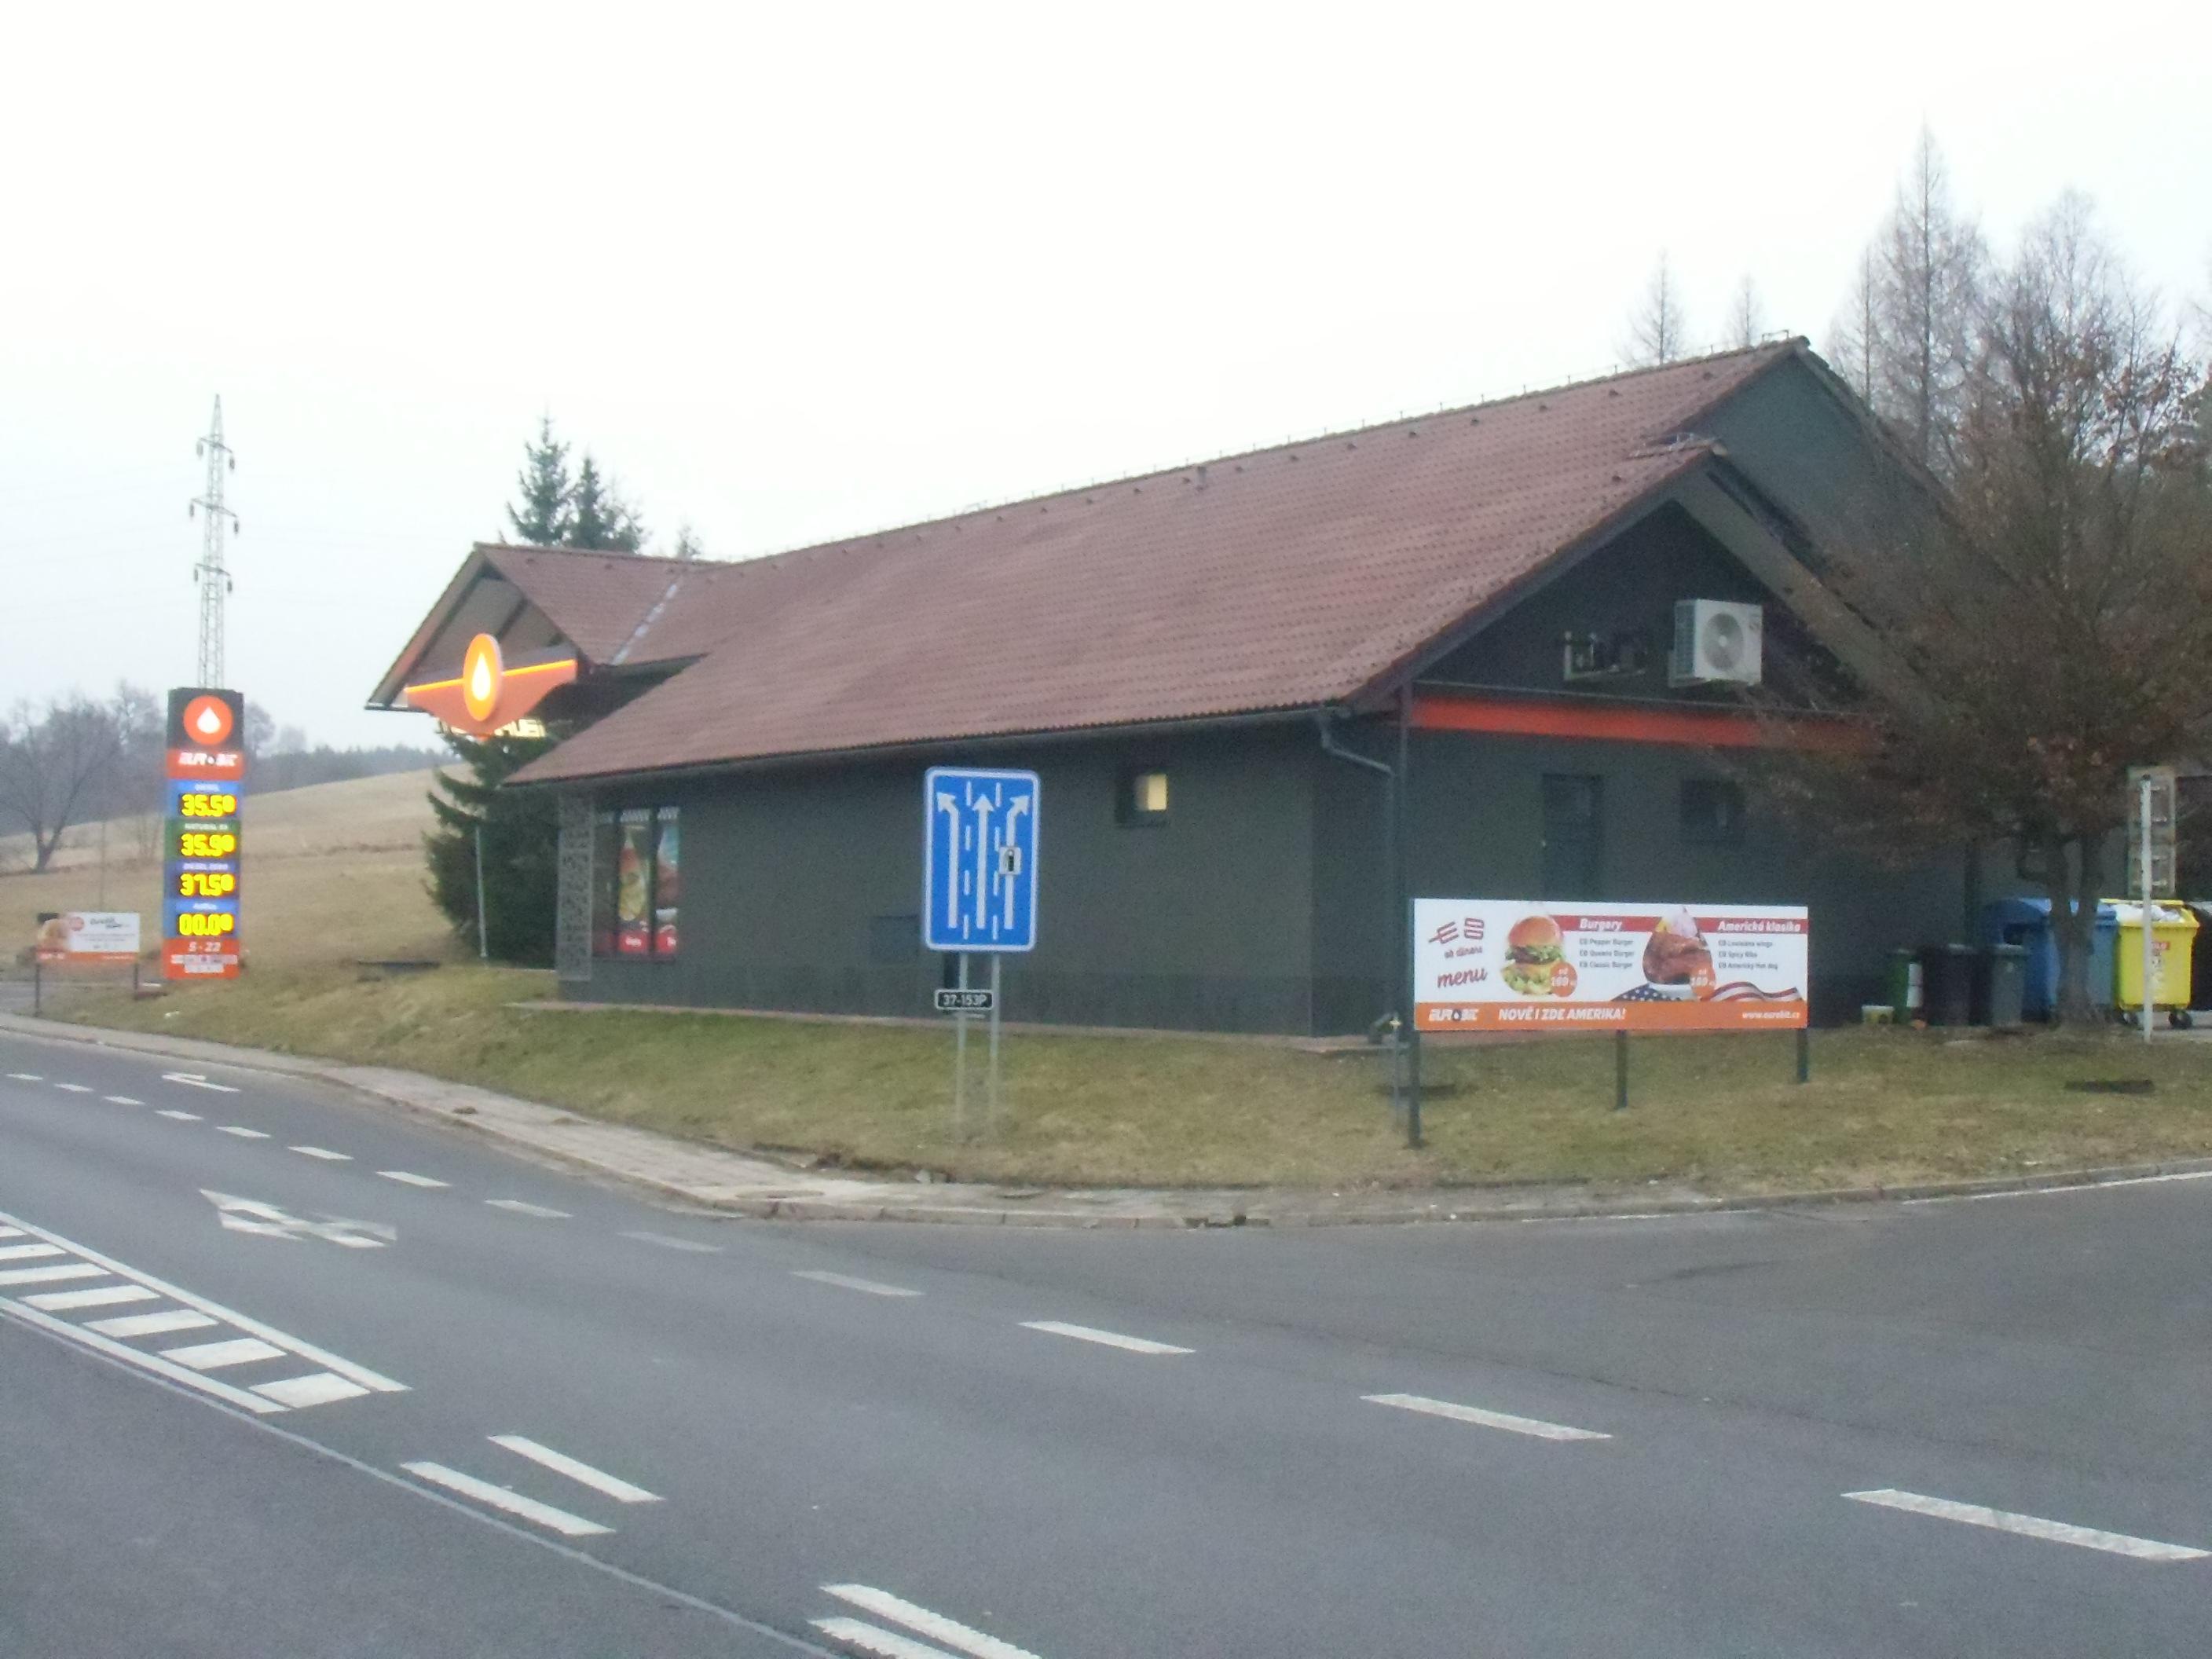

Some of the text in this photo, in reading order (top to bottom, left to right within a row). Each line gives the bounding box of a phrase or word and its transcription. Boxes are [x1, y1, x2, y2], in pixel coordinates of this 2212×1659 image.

[1580, 918, 1623, 931] Burgery
[1766, 921, 1801, 932] klasika
[1437, 968, 1488, 988] menu
[1541, 1008, 1566, 1020] ZDE
[1566, 1007, 1628, 1020] AMERIKA!
